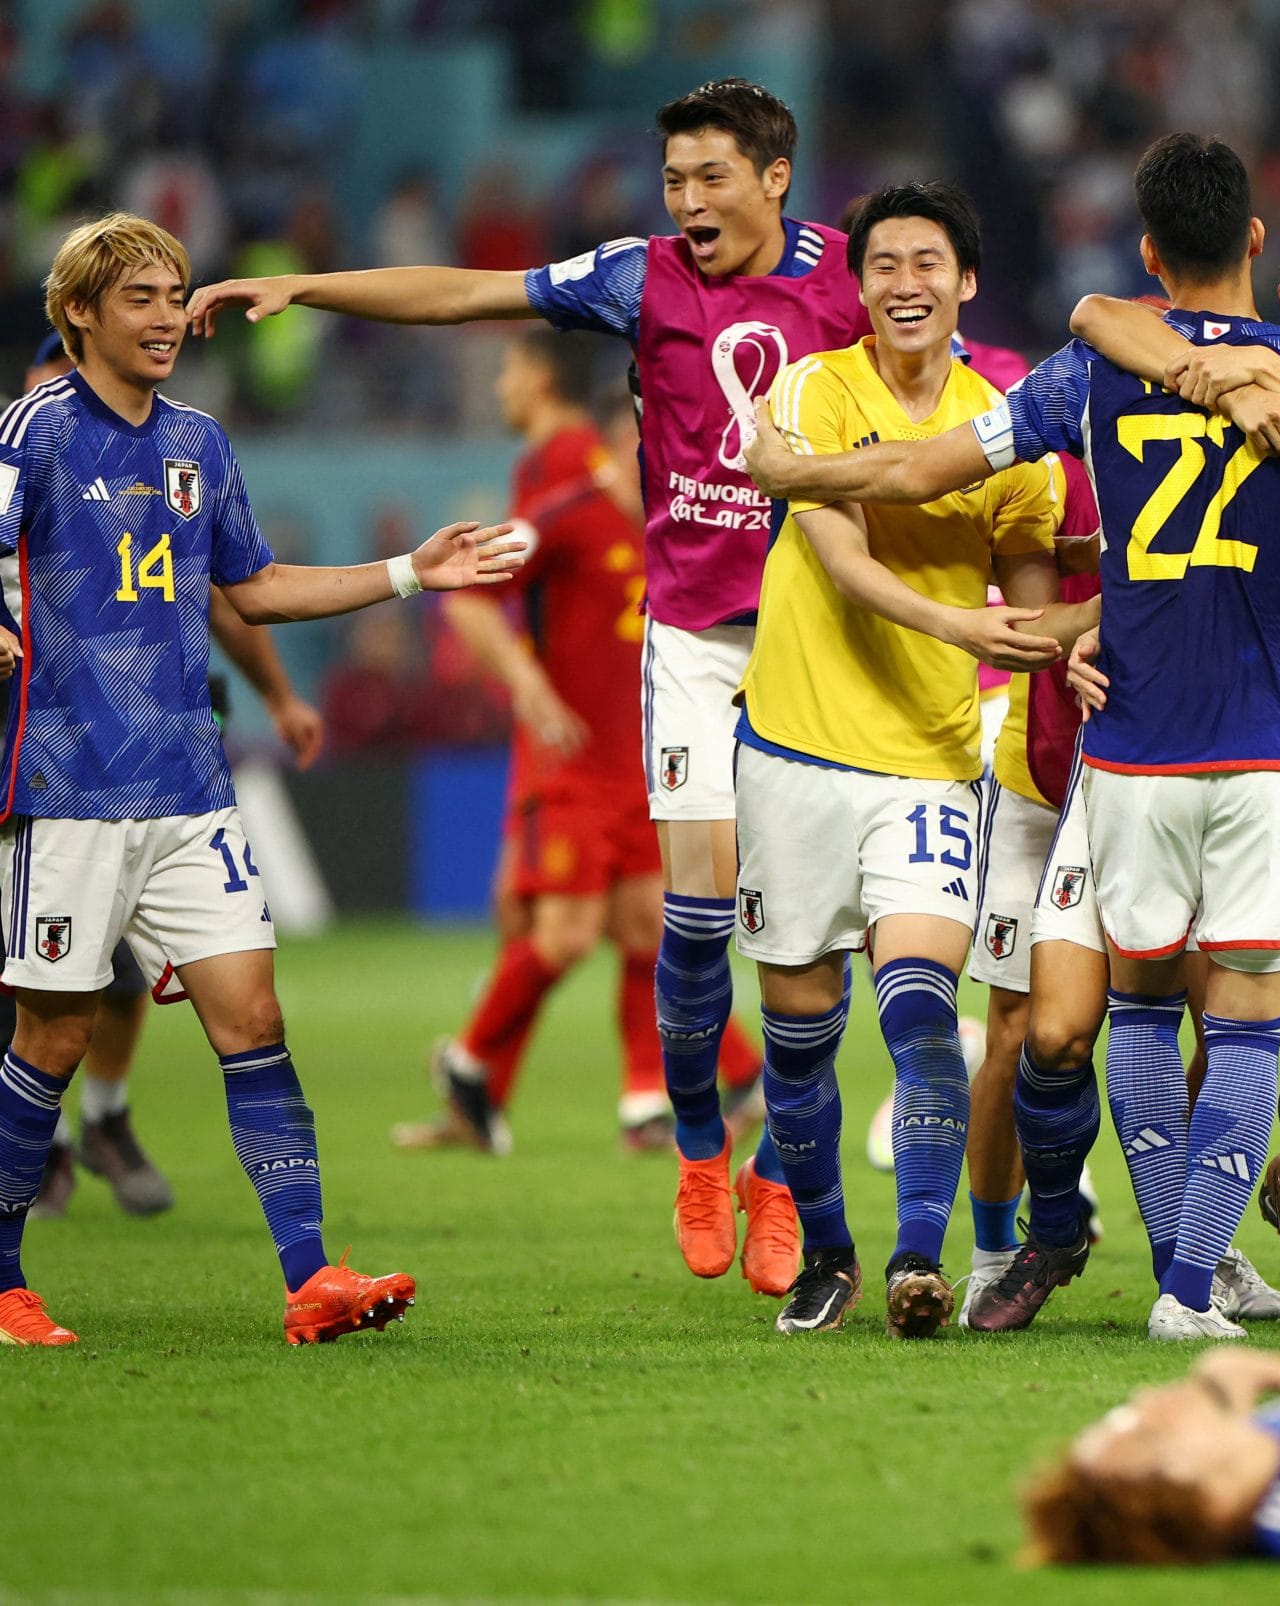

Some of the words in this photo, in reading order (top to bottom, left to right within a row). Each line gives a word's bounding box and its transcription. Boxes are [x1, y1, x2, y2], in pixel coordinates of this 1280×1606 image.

[698, 482, 772, 507] WORL
[1117, 412, 1269, 581] 22
[116, 531, 176, 602] 14
[905, 804, 972, 871] 15
[897, 1116, 966, 1133] JAPAN
